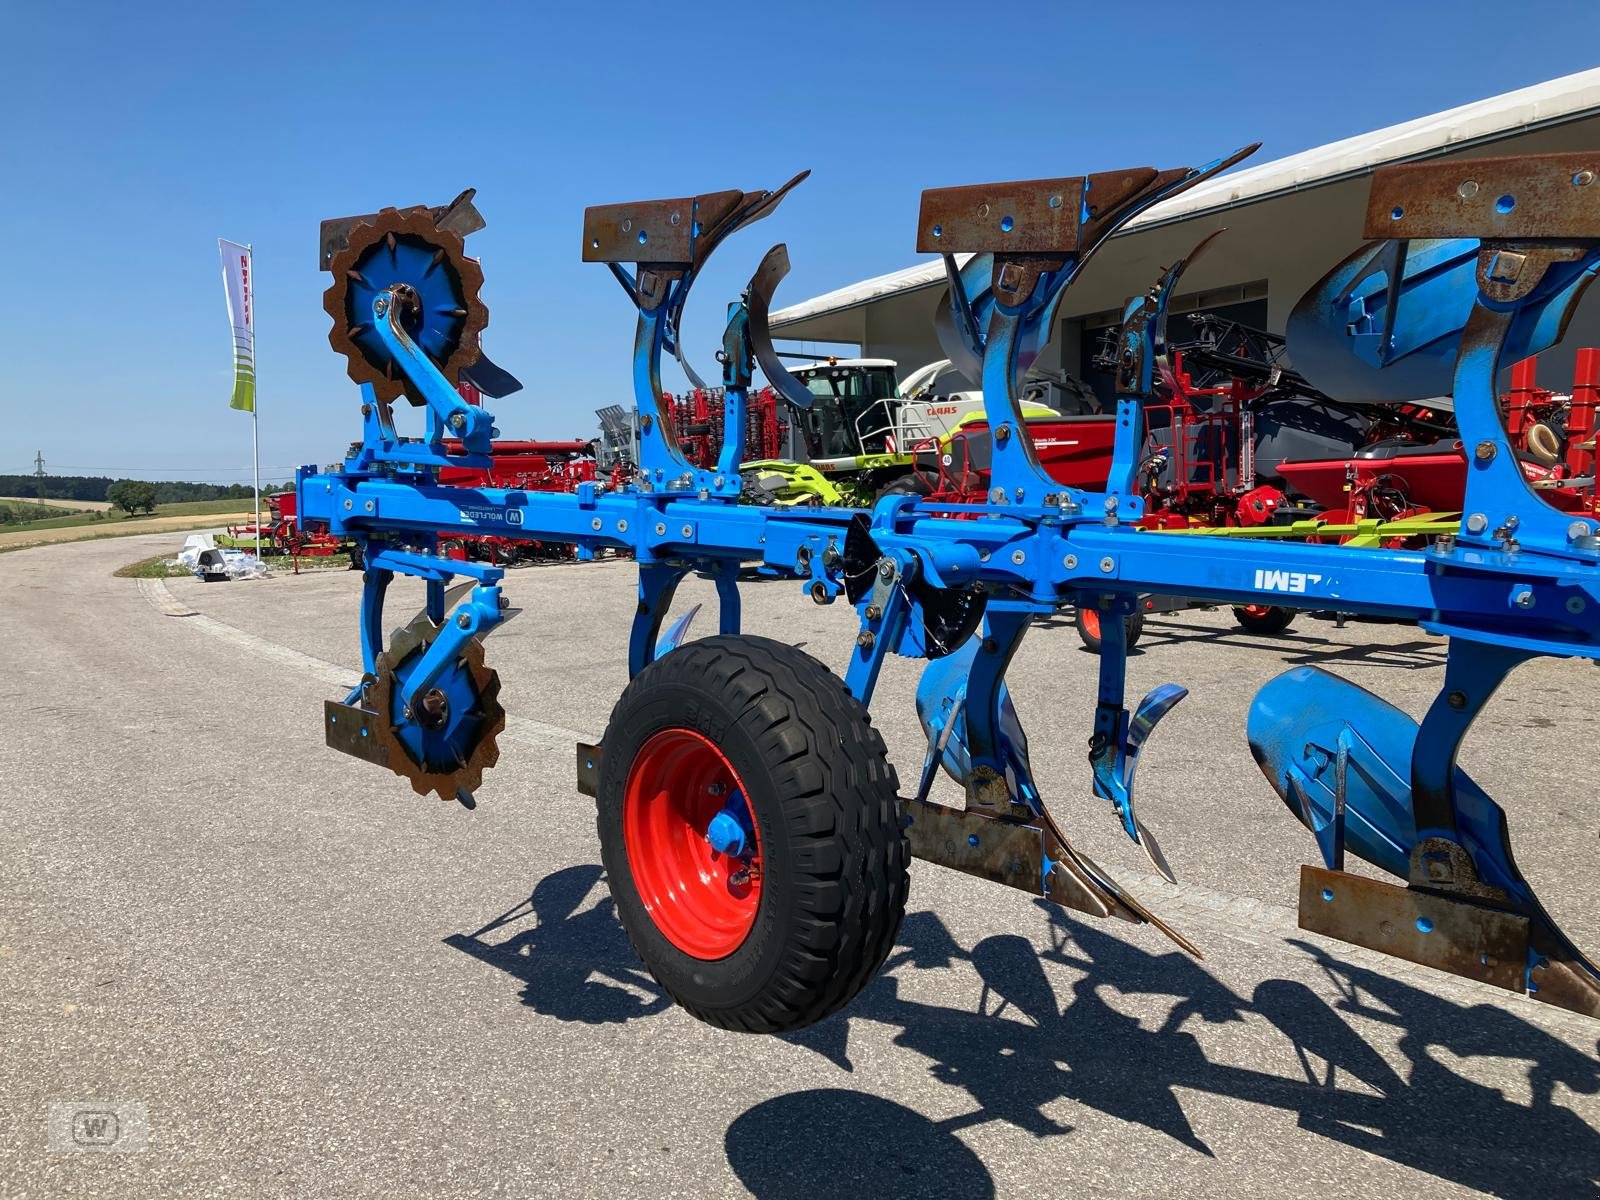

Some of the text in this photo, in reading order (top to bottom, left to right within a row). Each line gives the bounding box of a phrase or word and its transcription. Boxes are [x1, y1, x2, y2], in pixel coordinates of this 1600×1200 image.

[927, 406, 957, 416] CLAAS
[943, 455, 950, 464] 40
[509, 512, 520, 522] W
